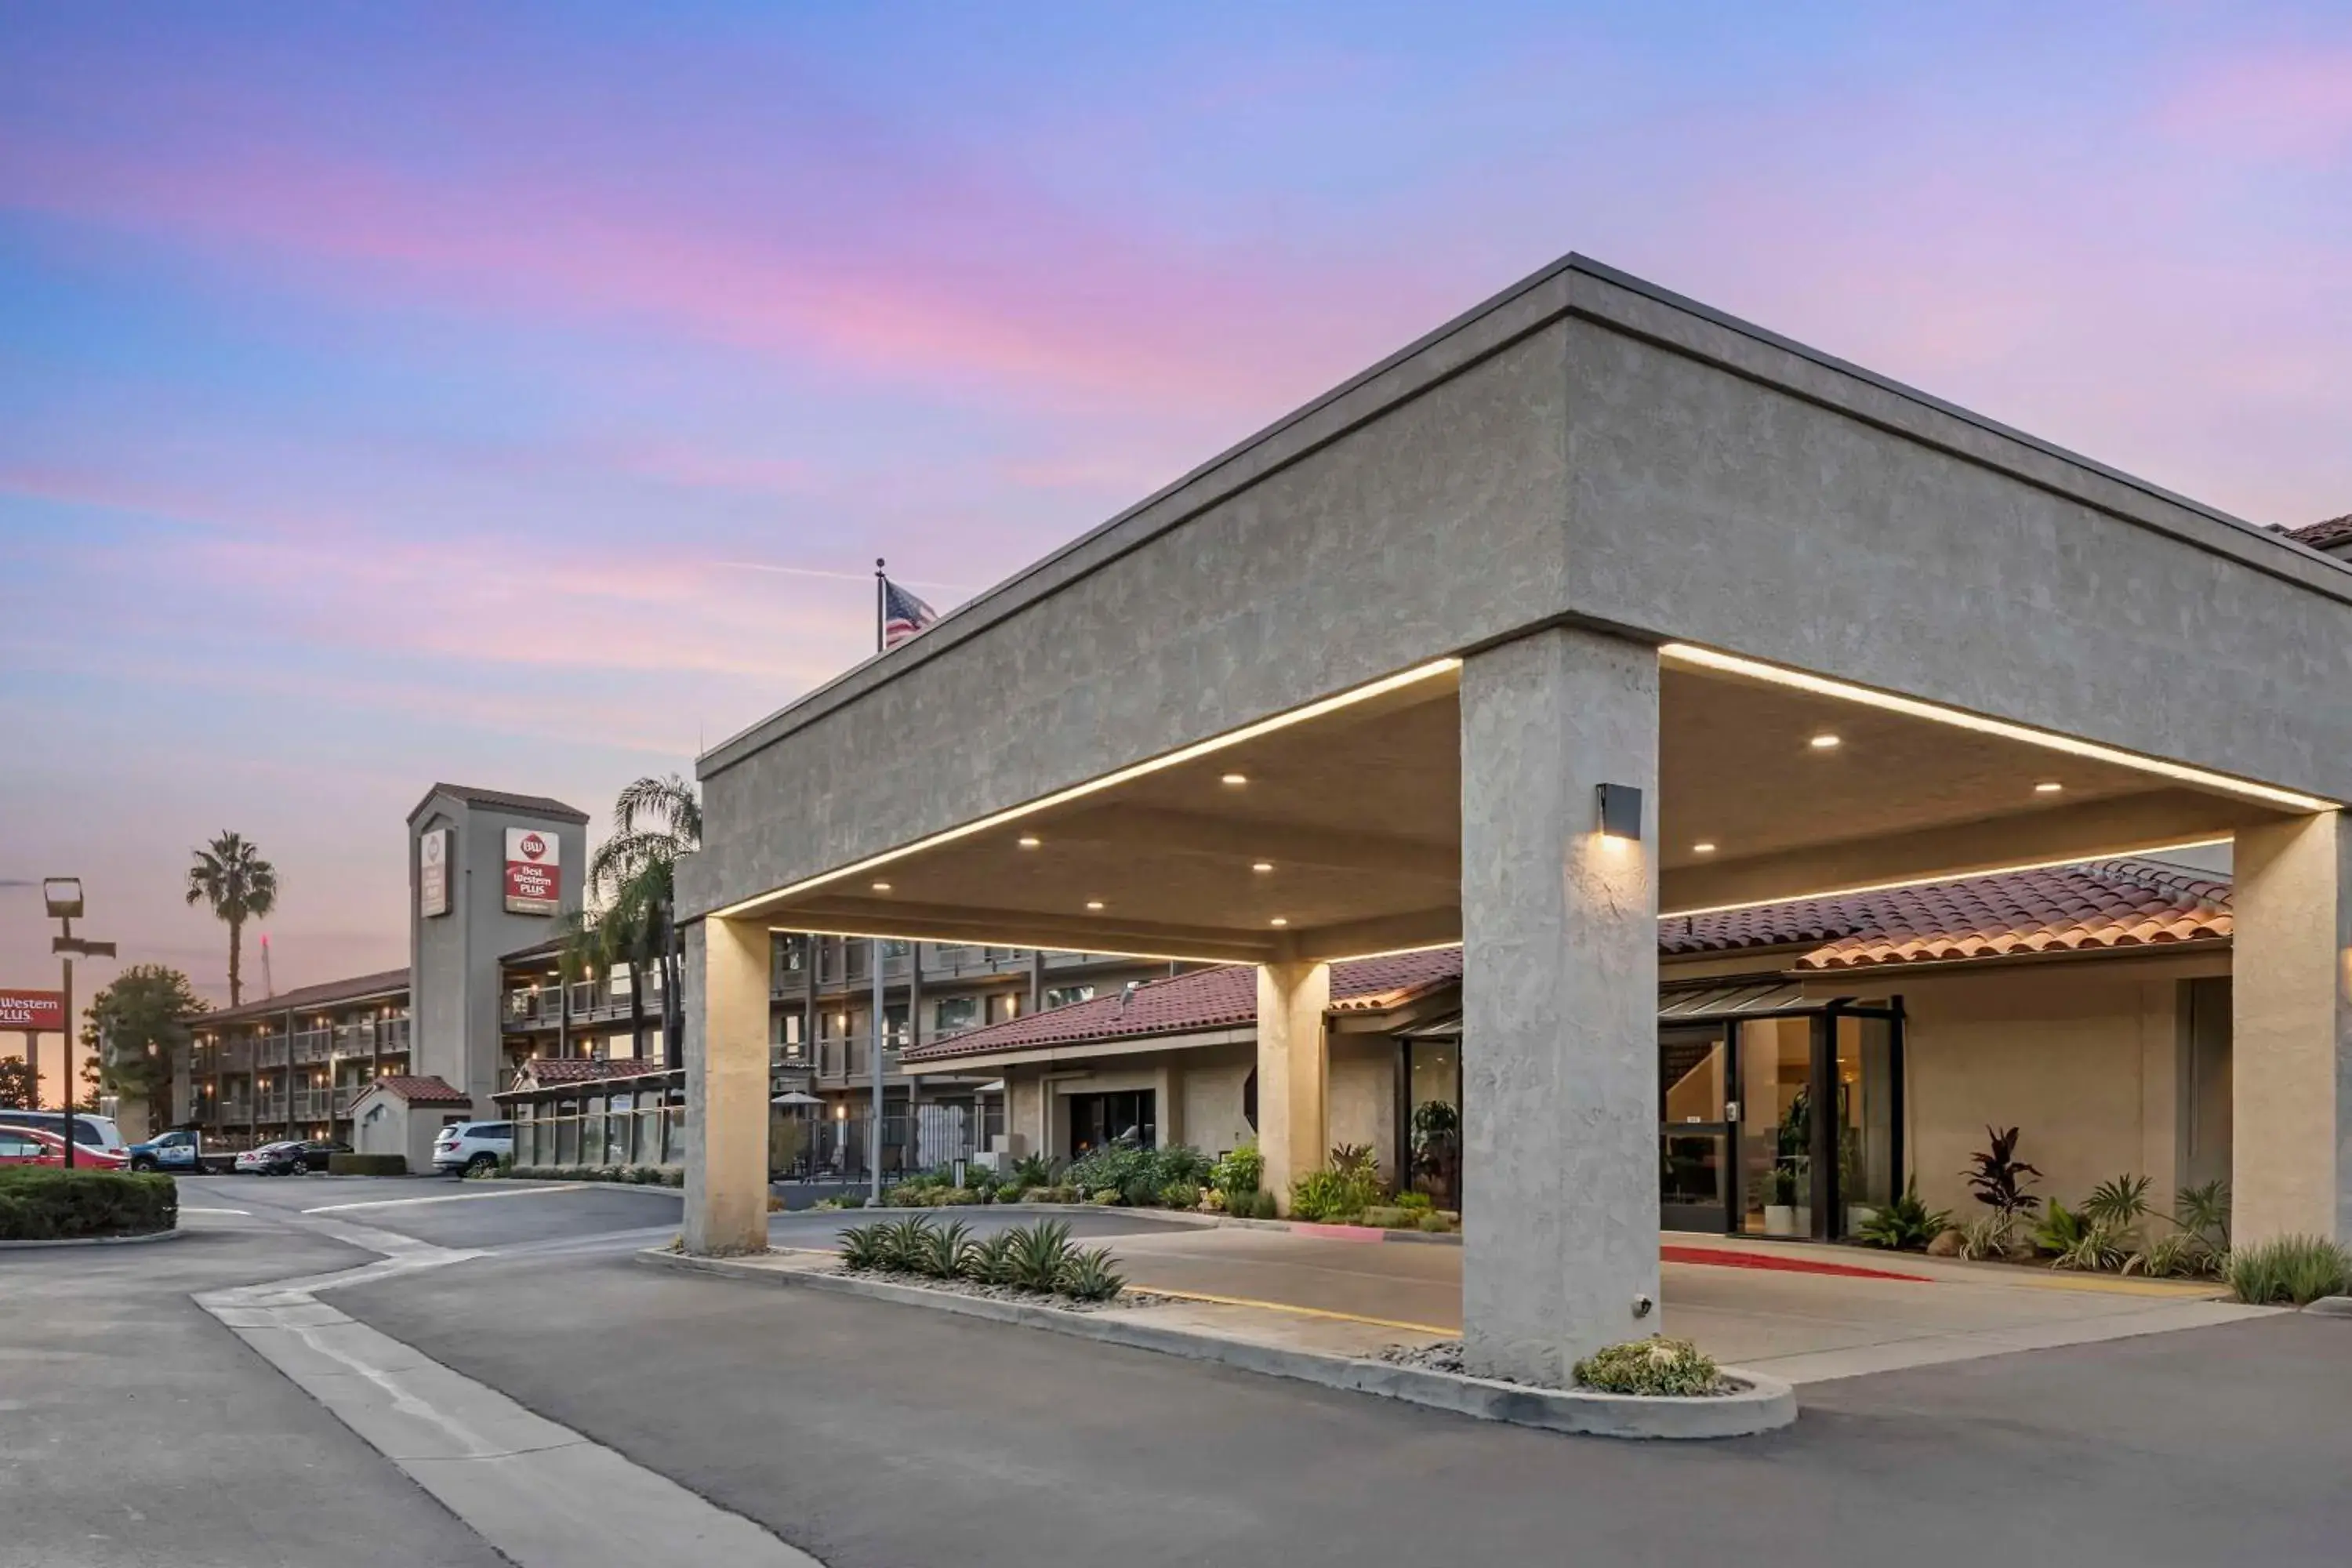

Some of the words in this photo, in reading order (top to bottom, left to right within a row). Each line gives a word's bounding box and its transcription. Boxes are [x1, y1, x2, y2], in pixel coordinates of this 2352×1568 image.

[523, 840, 543, 852] BW
[522, 866, 543, 877] Best
[514, 873, 551, 885] Western
[520, 884, 545, 895] PLUS
[1, 996, 57, 1010] Western
